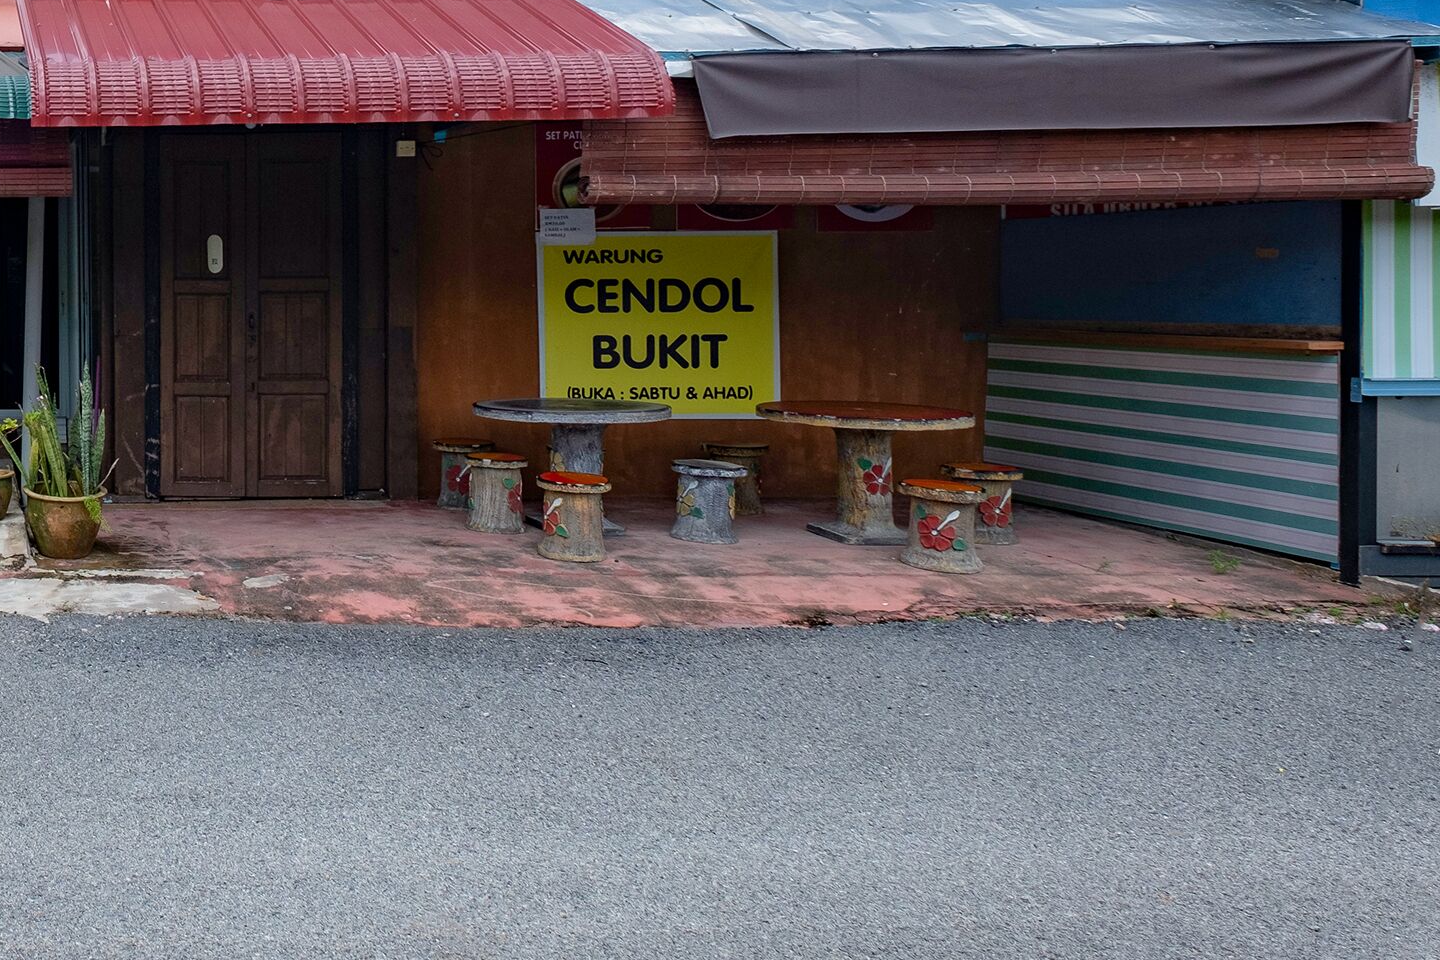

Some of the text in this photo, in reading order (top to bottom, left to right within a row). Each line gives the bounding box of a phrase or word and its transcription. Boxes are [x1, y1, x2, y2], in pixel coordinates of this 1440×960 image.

[545, 131, 561, 140] SET
[563, 248, 664, 265] WARUNG
[564, 276, 755, 314] CENDOL
[592, 333, 729, 370] BUKIT
[567, 386, 616, 399] (BUKA
[629, 386, 681, 400] SABTU
[685, 386, 698, 400] &
[702, 385, 753, 401] AHAD)
